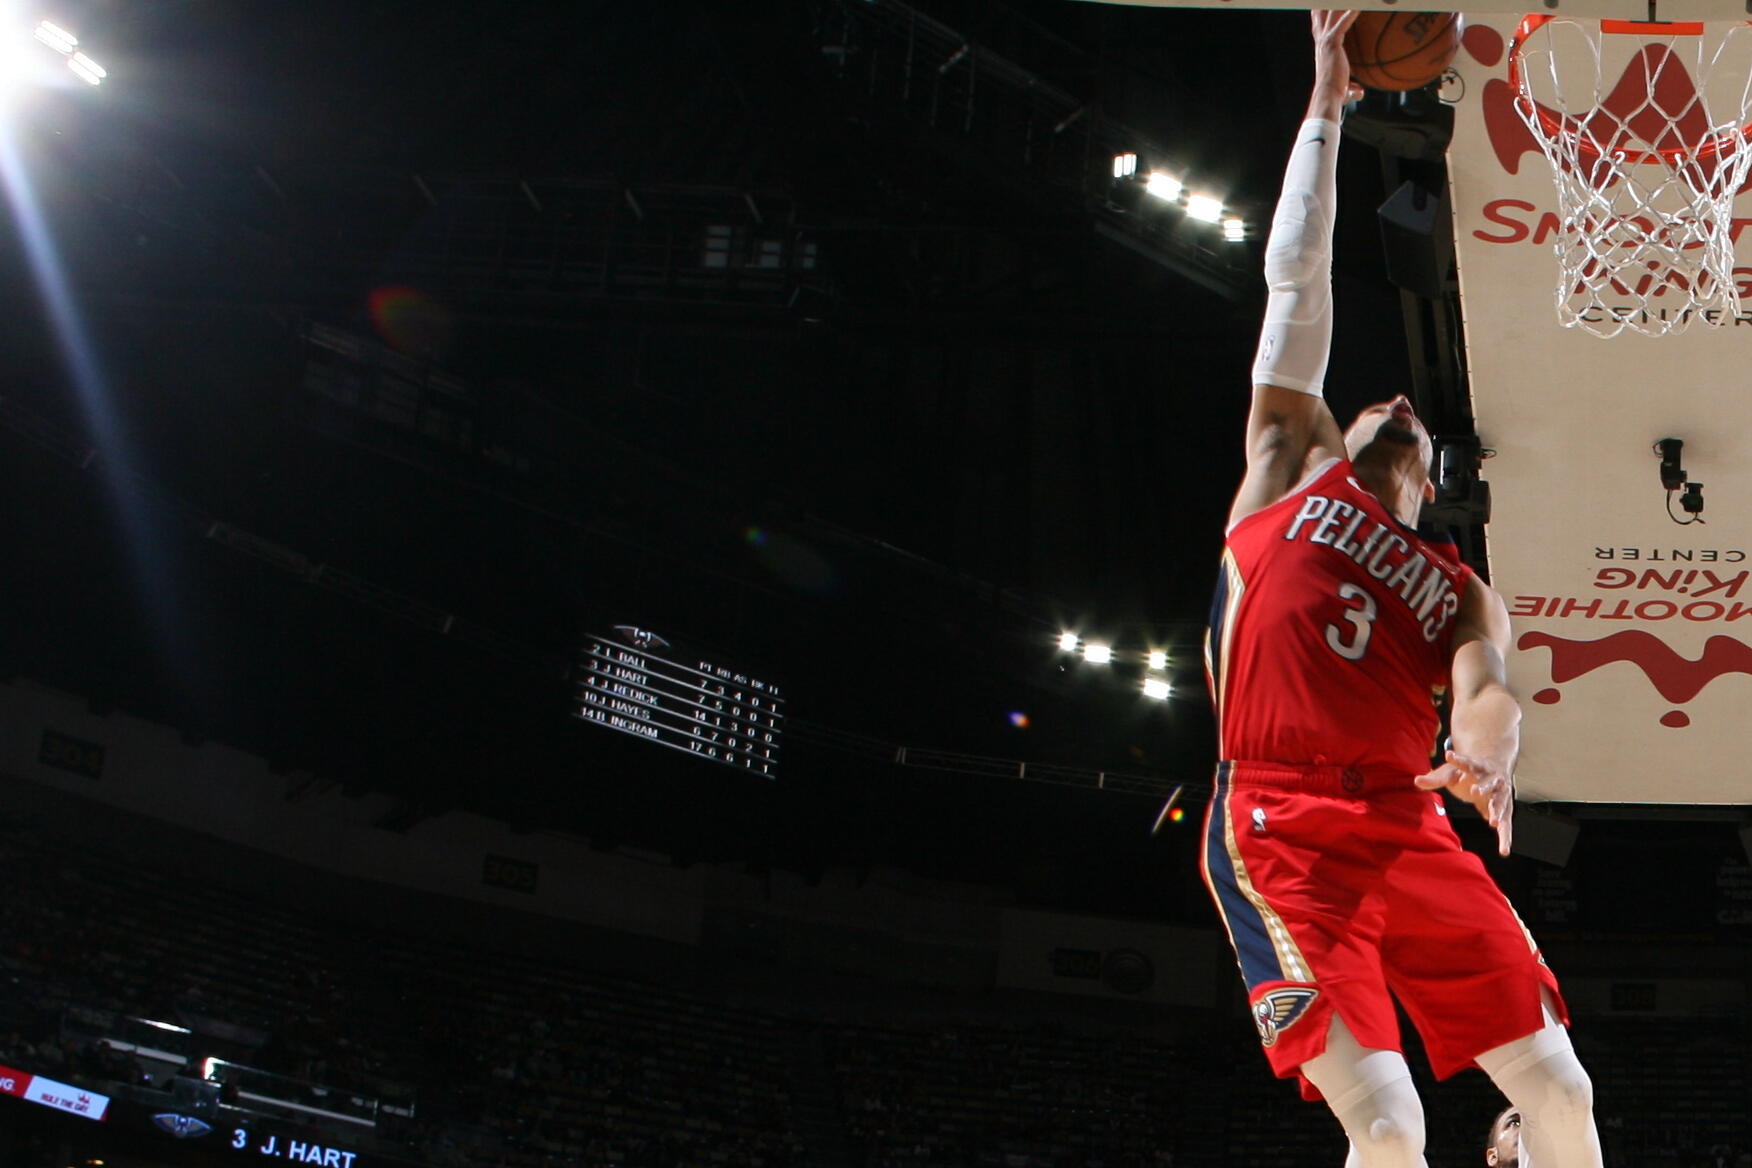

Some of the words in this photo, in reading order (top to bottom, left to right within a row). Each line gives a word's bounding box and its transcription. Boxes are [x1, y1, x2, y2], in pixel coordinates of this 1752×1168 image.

[1594, 547, 1746, 562] CENTER
[1325, 582, 1378, 661] 3
[231, 1128, 248, 1150] 3
[260, 1135, 280, 1157] J.
